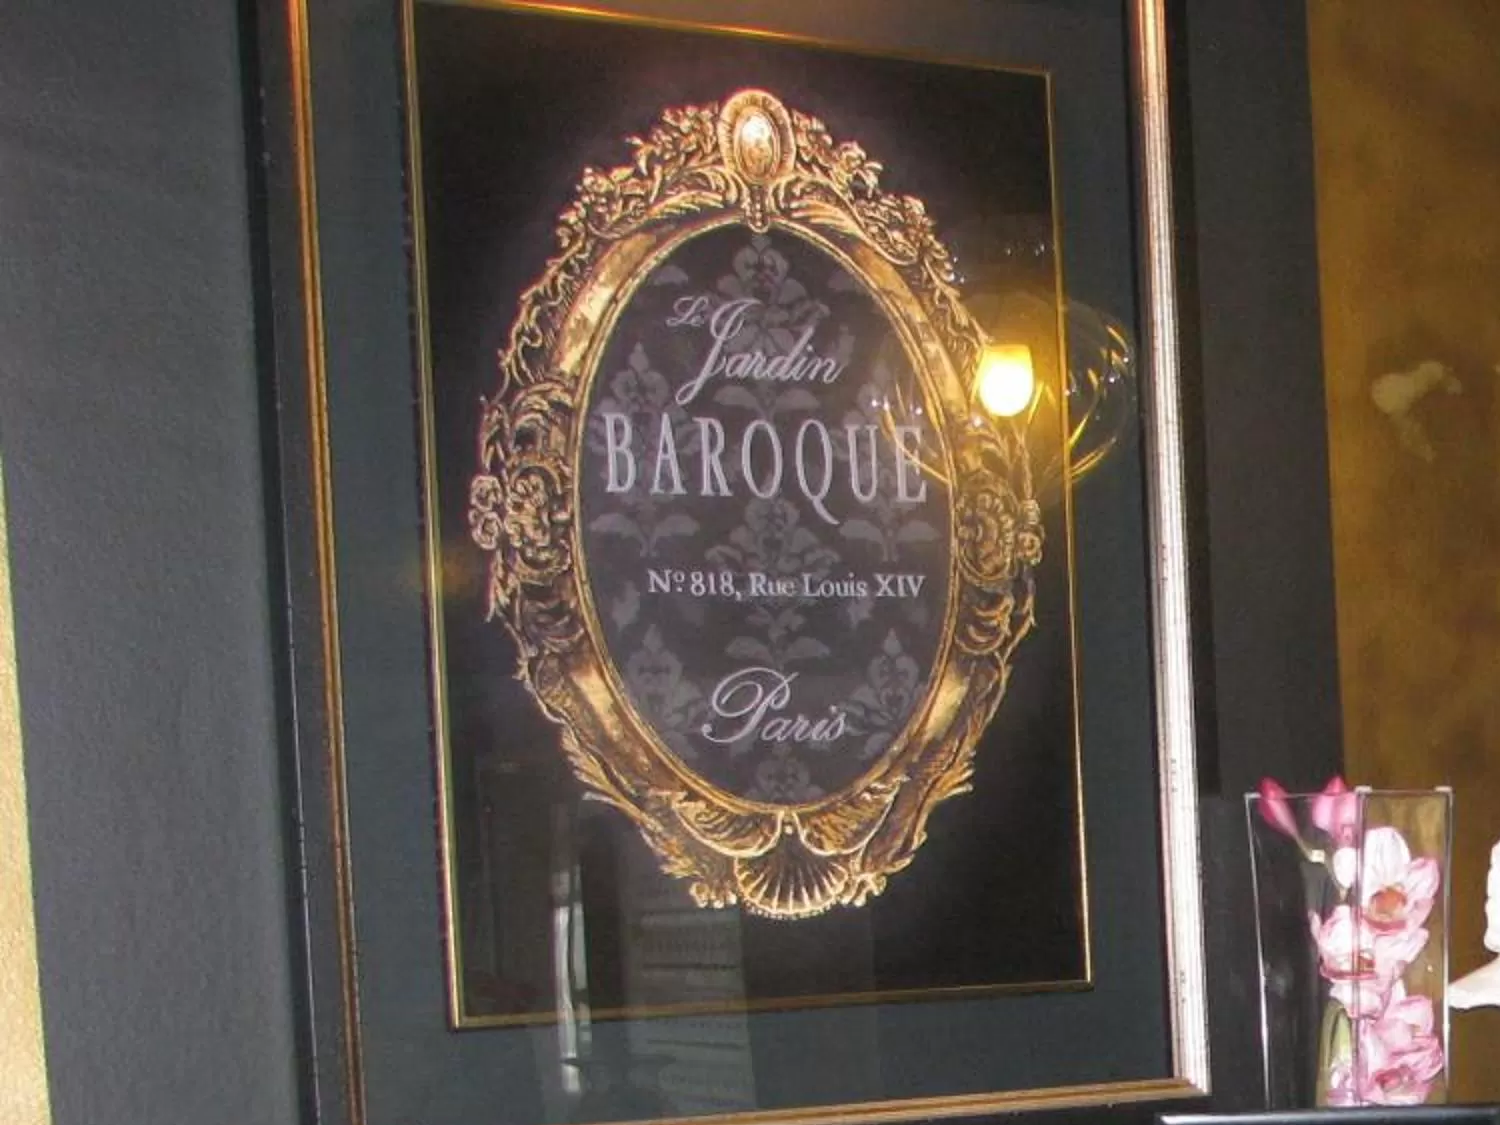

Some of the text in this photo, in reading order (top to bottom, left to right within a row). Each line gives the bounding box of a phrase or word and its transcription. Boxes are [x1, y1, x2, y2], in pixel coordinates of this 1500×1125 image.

[675, 297, 846, 405] Jardin
[602, 411, 927, 525] BAROQUE
[748, 571, 797, 598] Rue
[803, 572, 867, 598] Louis
[873, 572, 926, 598] XIV
[701, 666, 846, 743] Paris
